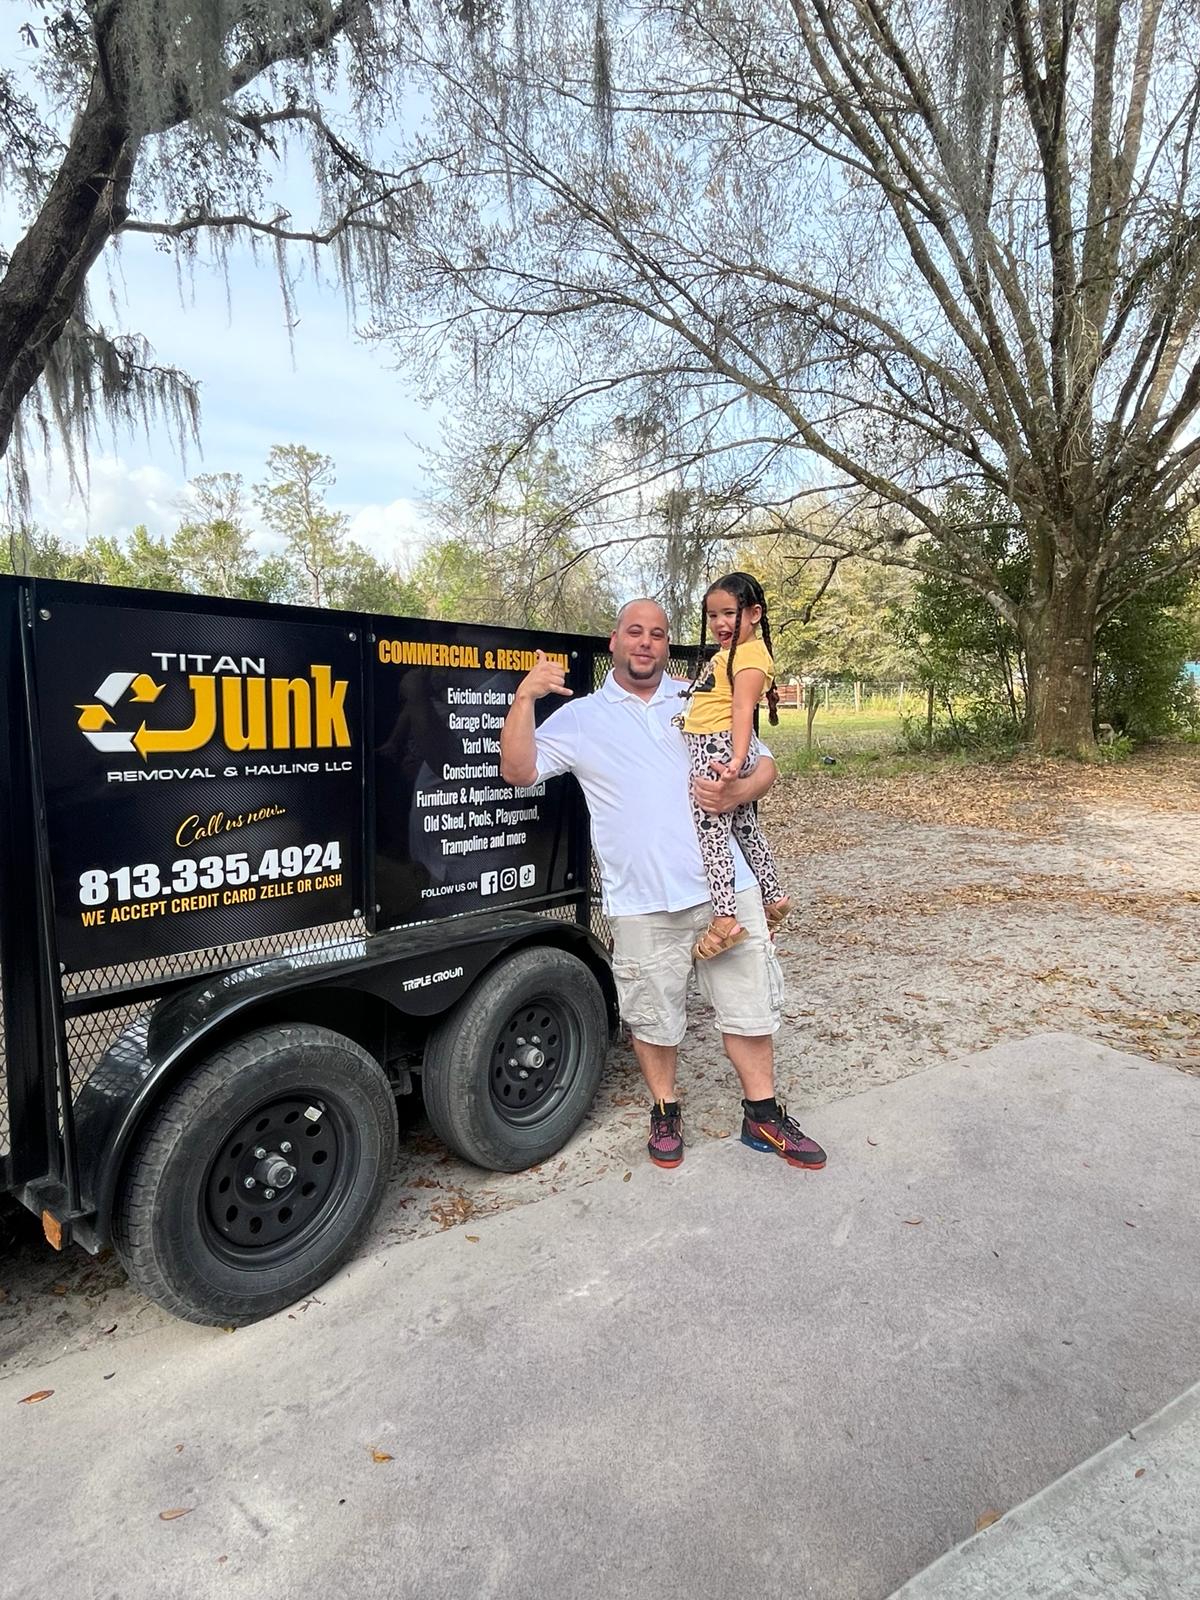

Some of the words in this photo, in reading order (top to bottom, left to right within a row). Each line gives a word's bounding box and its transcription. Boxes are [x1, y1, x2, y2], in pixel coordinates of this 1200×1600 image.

[152, 652, 265, 675] TITAN
[378, 639, 481, 668] COMMERCIAL
[485, 651, 495, 669] &
[497, 649, 570, 673] RESIDTIAL
[447, 687, 482, 705] Eviction
[484, 689, 505, 705] clean
[133, 665, 352, 758] Junk
[449, 713, 480, 732] Garage
[462, 738, 481, 755] Yard
[107, 767, 216, 783] REMOVAL
[223, 766, 239, 777] &
[245, 762, 320, 776] HAULING
[325, 761, 353, 773] LLC
[443, 762, 499, 780] Construction
[416, 790, 458, 808] Furniture
[460, 787, 467, 804] &
[469, 786, 513, 806] Appliances
[514, 782, 546, 799] Removal
[175, 811, 224, 847] Call
[225, 814, 246, 832] us
[424, 815, 440, 833] Old
[441, 812, 467, 831] Shed,
[469, 810, 494, 829] Pools,
[496, 805, 540, 826] Playground,
[440, 835, 488, 856] Trampoline
[490, 832, 505, 849] and
[506, 832, 526, 846] more
[79, 841, 342, 906] 813.335.4924
[81, 909, 106, 928] WE
[110, 901, 168, 924] ACCEPT
[171, 893, 220, 914] CREDIT
[223, 888, 256, 906] CARD
[260, 882, 294, 900] ZELLE
[297, 879, 312, 894] OR
[315, 874, 342, 890] CASH
[421, 885, 454, 899] FOLLOW
[455, 883, 466, 893] US
[467, 881, 478, 891] ON
[402, 975, 432, 992] TRIPLE
[432, 966, 464, 983] CROWN
